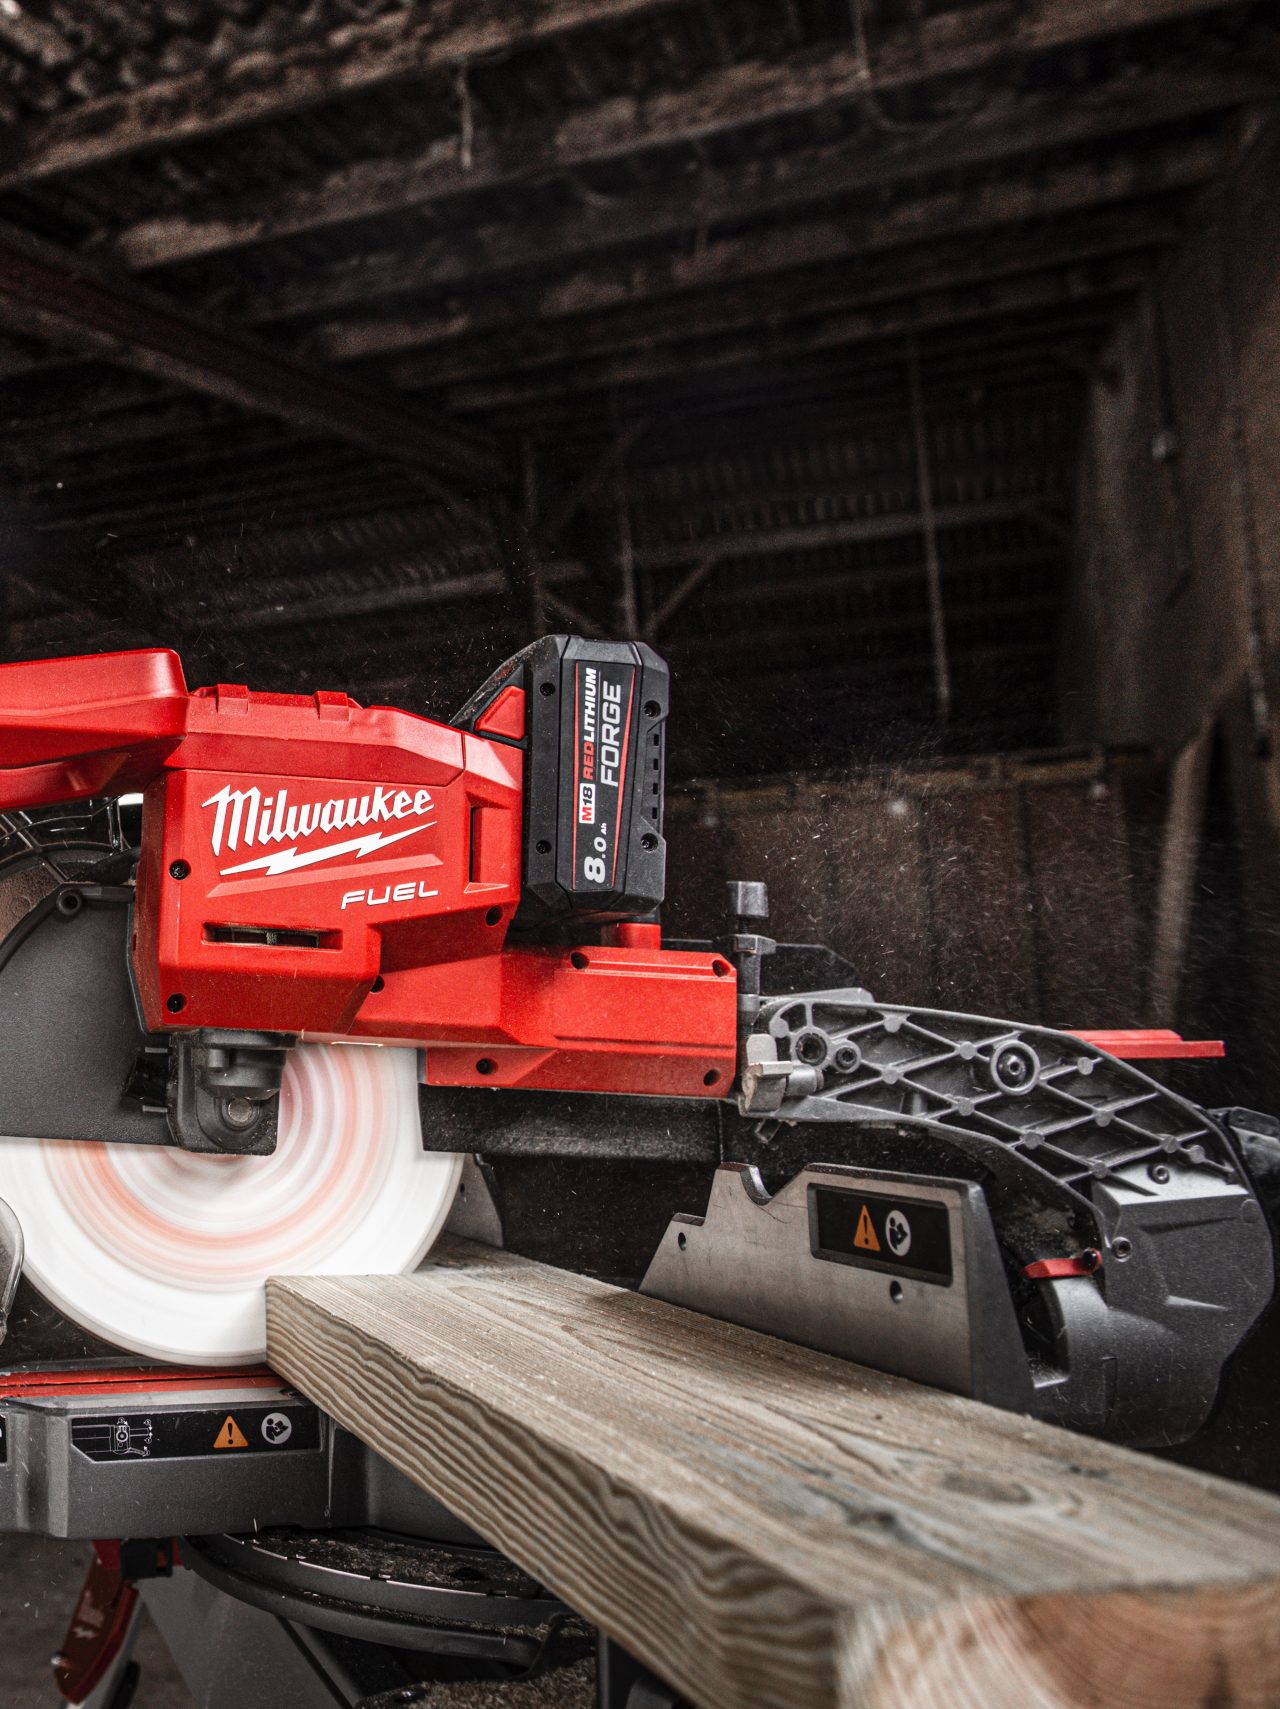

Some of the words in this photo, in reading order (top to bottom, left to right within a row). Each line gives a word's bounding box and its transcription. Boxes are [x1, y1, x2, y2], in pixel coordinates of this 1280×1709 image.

[583, 668, 596, 779] REDLITHIUM
[601, 681, 620, 787] FORGE
[201, 784, 435, 857] Milwaukee
[581, 785, 593, 822] M18
[584, 837, 606, 883] 8.0
[601, 822, 607, 835] Ah
[341, 881, 438, 909] FUEL
